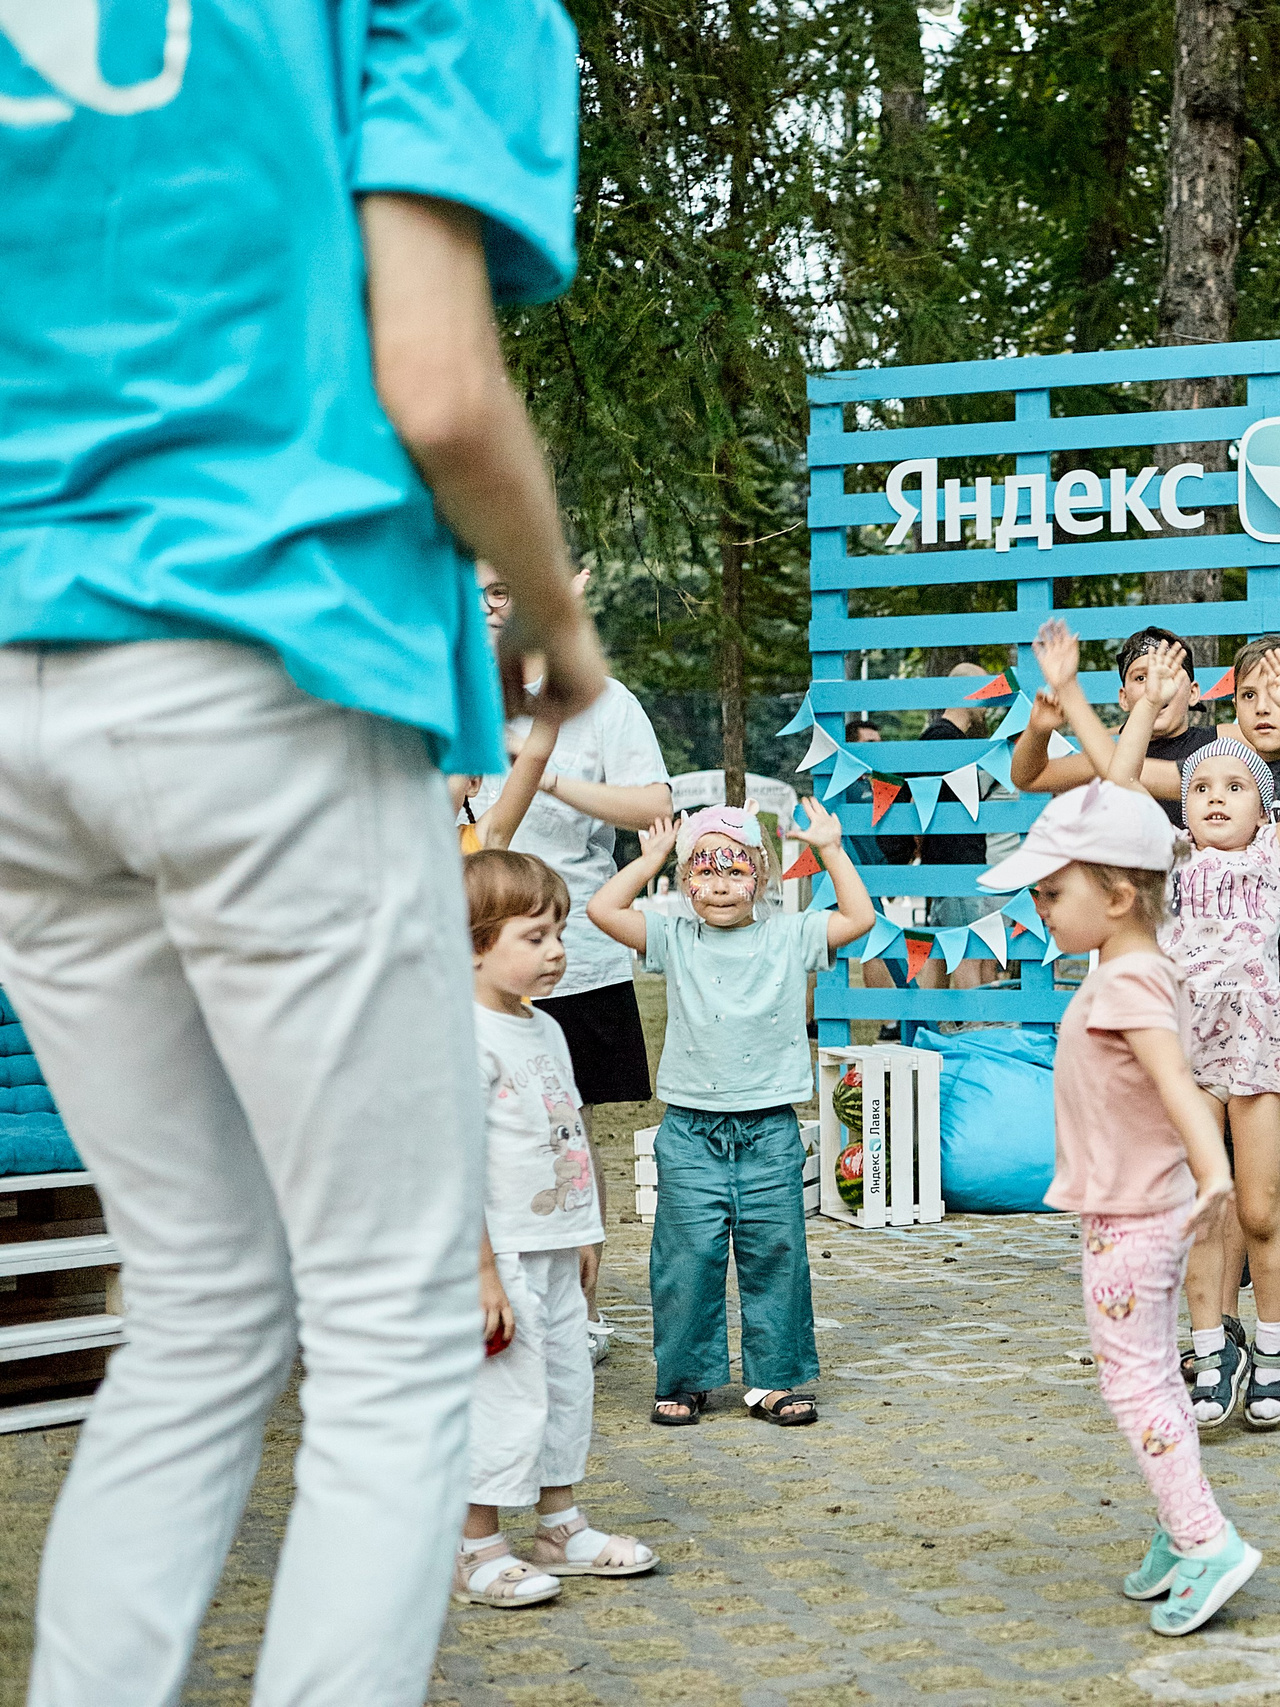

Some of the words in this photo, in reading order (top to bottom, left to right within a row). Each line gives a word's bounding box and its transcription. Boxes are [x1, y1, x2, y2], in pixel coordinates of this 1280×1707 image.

[884, 457, 1205, 552] Яндекс
[1179, 867, 1263, 920] MEOW
[869, 1099, 880, 1136] Лавка
[871, 1153, 881, 1194] Яндекс
